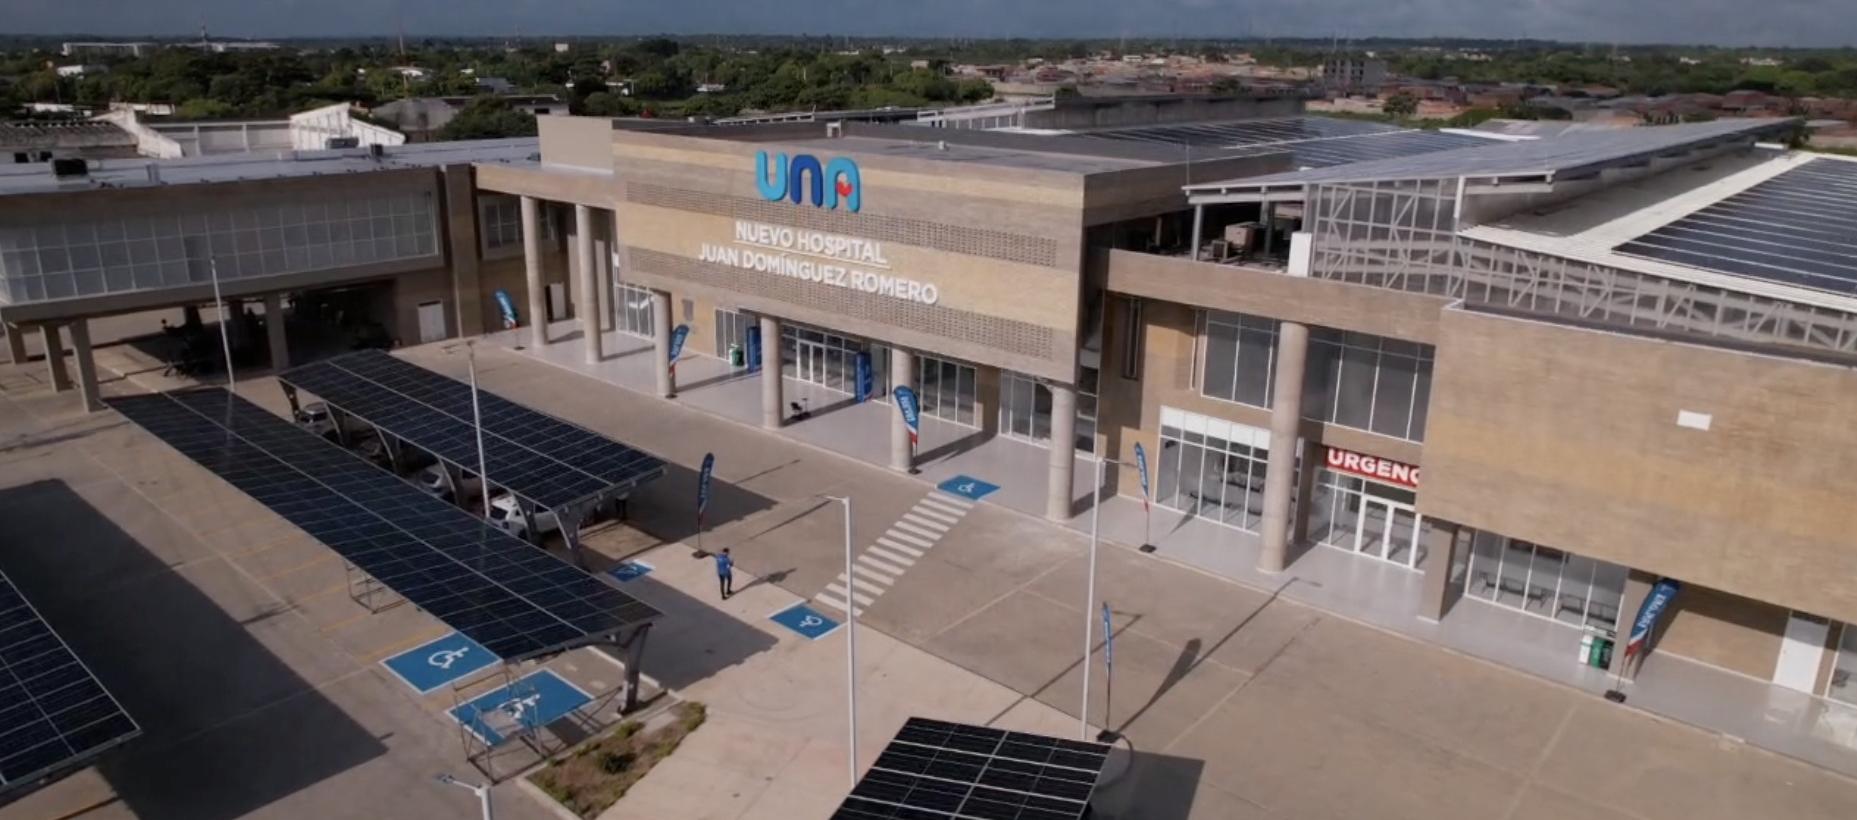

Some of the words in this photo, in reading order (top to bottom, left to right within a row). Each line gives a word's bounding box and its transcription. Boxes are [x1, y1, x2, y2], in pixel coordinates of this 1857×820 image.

[735, 221, 793, 248] NUEVO
[797, 232, 887, 264] HOSPITAL
[698, 243, 738, 267] JUAN
[743, 252, 849, 287] DOMÍNGUEZ
[851, 270, 938, 305] ROMERO
